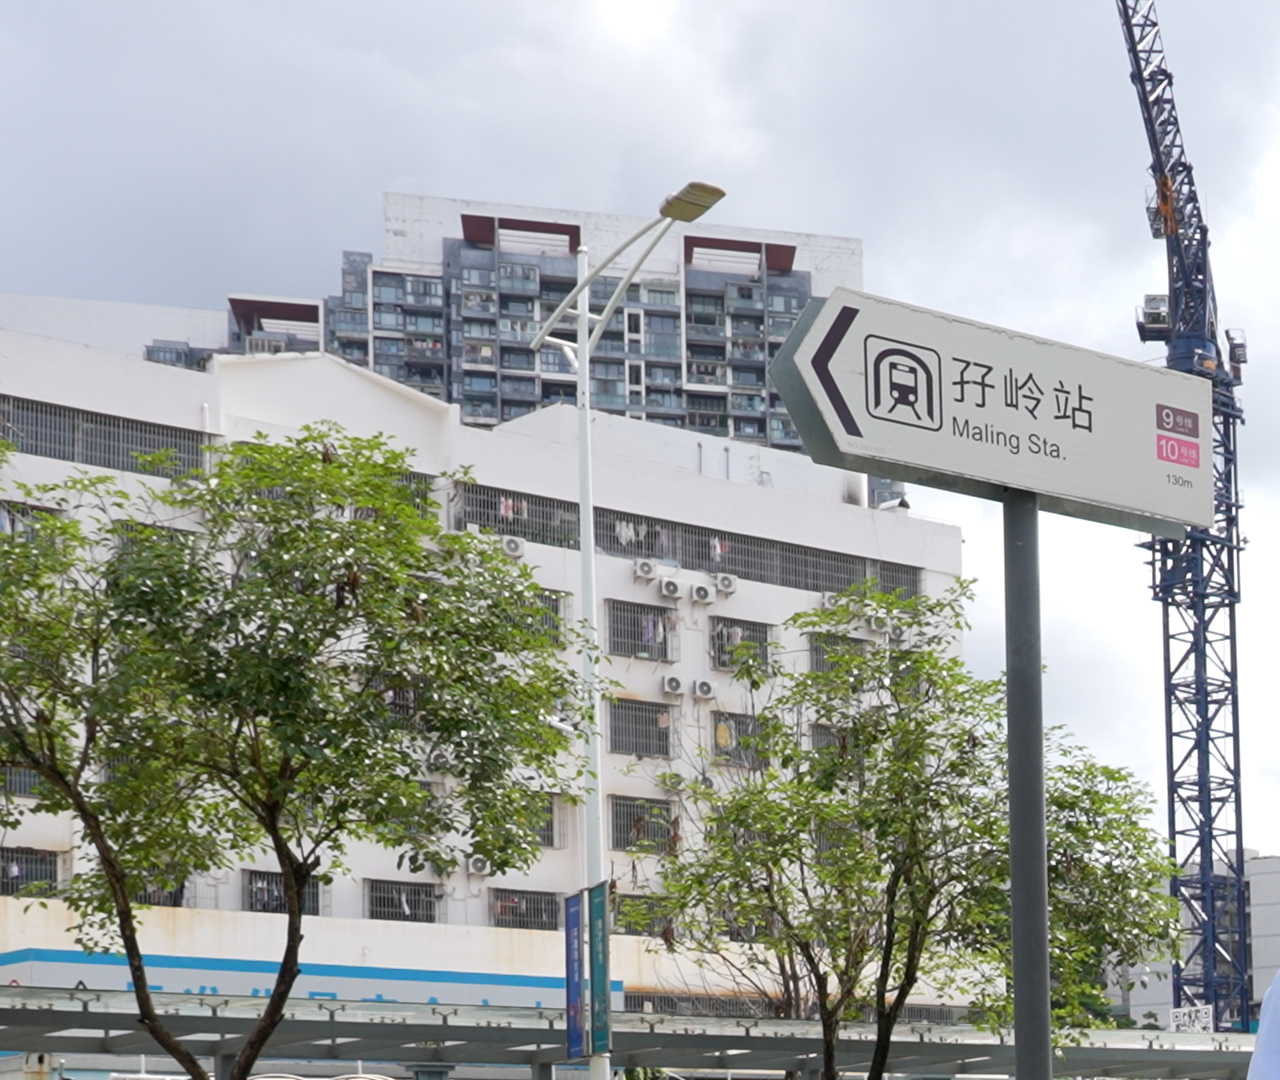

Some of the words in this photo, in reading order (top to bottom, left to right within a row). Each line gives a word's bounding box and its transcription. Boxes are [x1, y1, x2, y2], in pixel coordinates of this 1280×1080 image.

[952, 357, 1094, 433] 孖岭站
[952, 416, 1021, 455] Maling
[1027, 433, 1067, 461] Sta.
[1166, 474, 1193, 488] 130m
